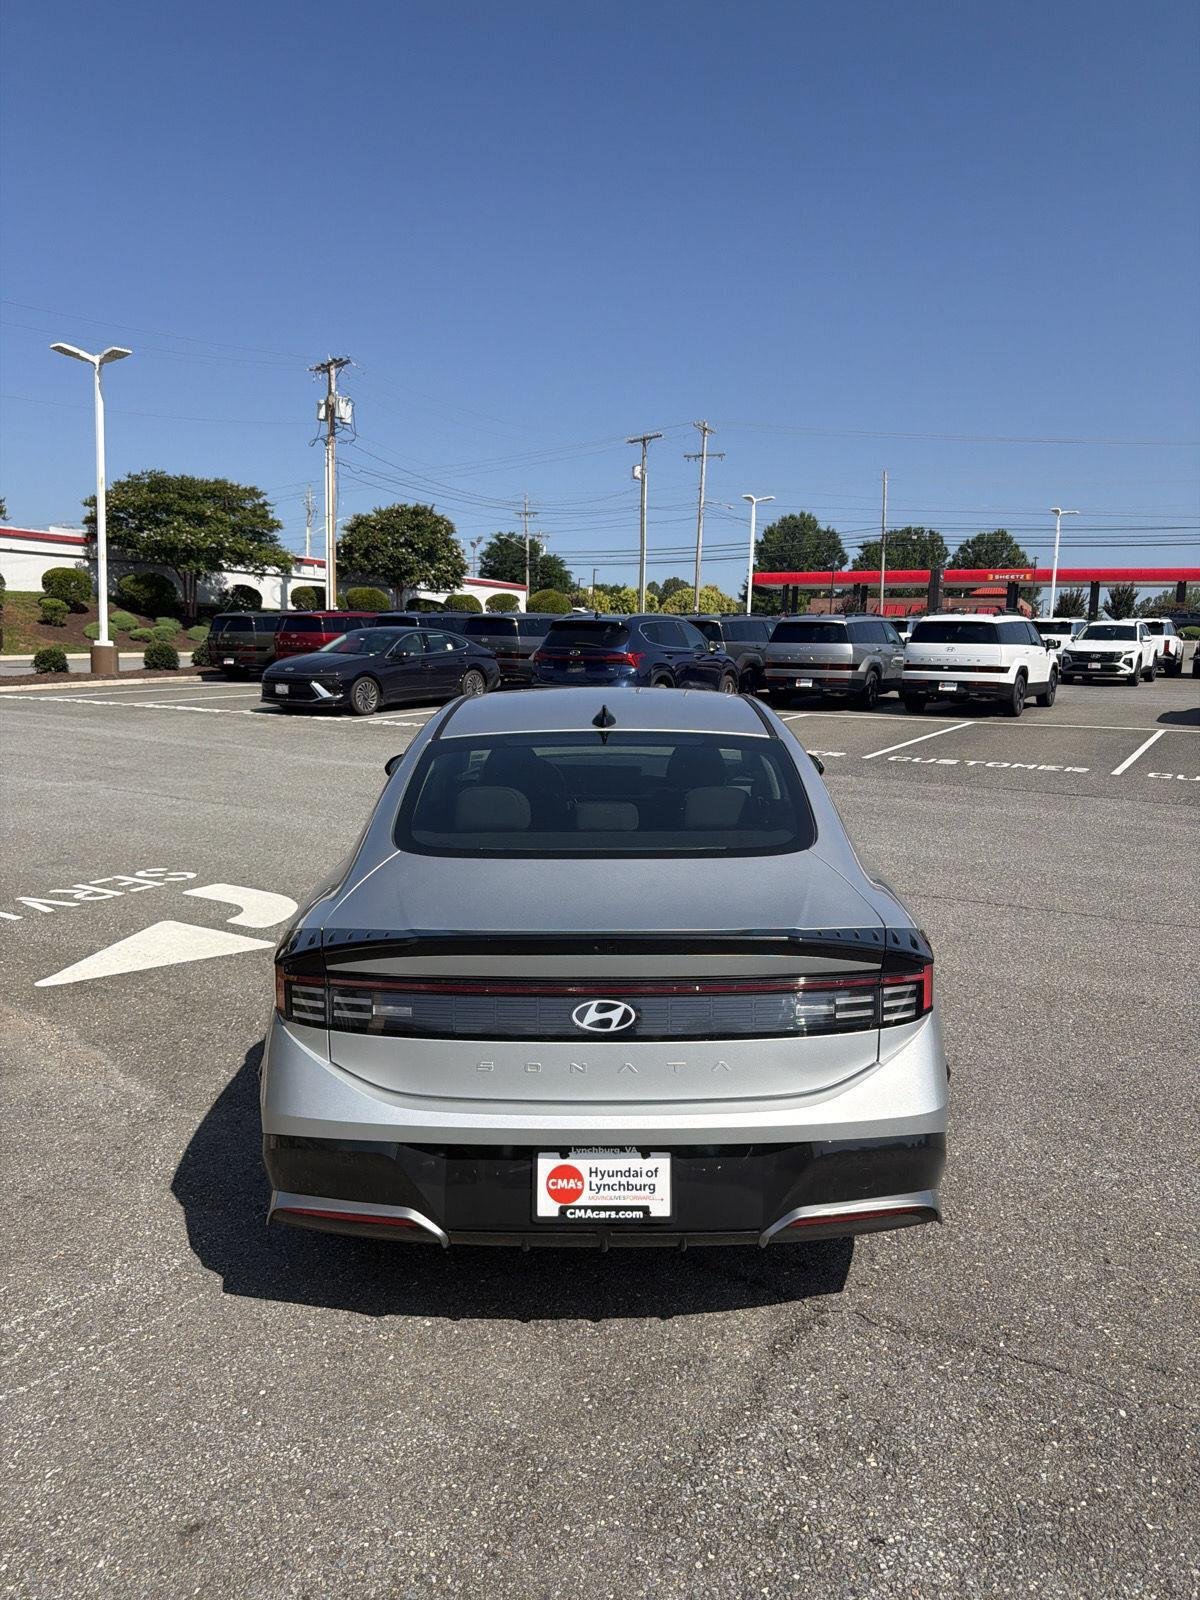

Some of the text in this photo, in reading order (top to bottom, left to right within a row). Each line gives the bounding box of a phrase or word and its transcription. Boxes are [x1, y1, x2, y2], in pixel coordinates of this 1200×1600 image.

[887, 756, 1090, 773] CUSTOMER
[476, 1060, 732, 1073] SONATA
[589, 1167, 659, 1181] Hyundai of
[548, 1178, 583, 1189] CMA's
[589, 1180, 656, 1194] Lynchburg
[566, 1208, 643, 1219] CMAcars.com
